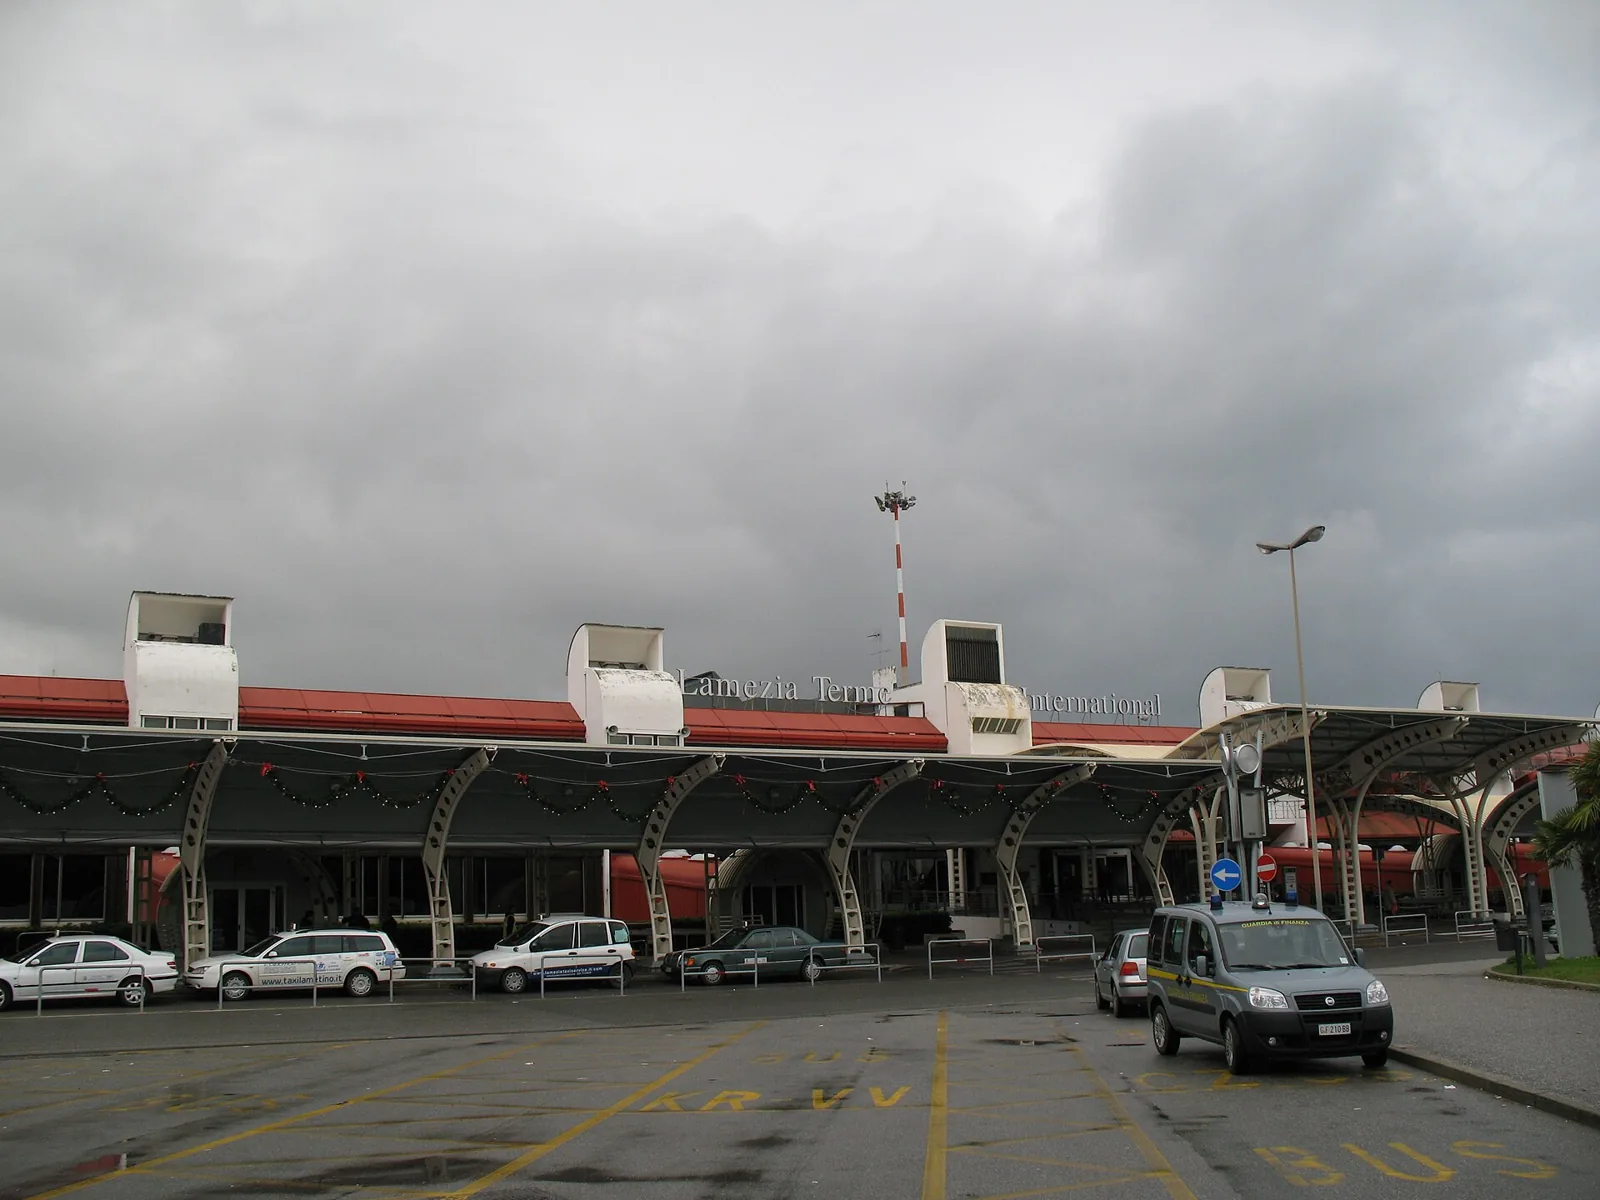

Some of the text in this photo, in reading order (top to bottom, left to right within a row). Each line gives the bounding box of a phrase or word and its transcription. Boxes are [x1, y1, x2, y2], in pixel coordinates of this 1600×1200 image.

[676, 668, 799, 701] Lamezia
[812, 676, 891, 704] Terme
[640, 1086, 912, 1111] KR VV
[1252, 1140, 1559, 1186] BUS
